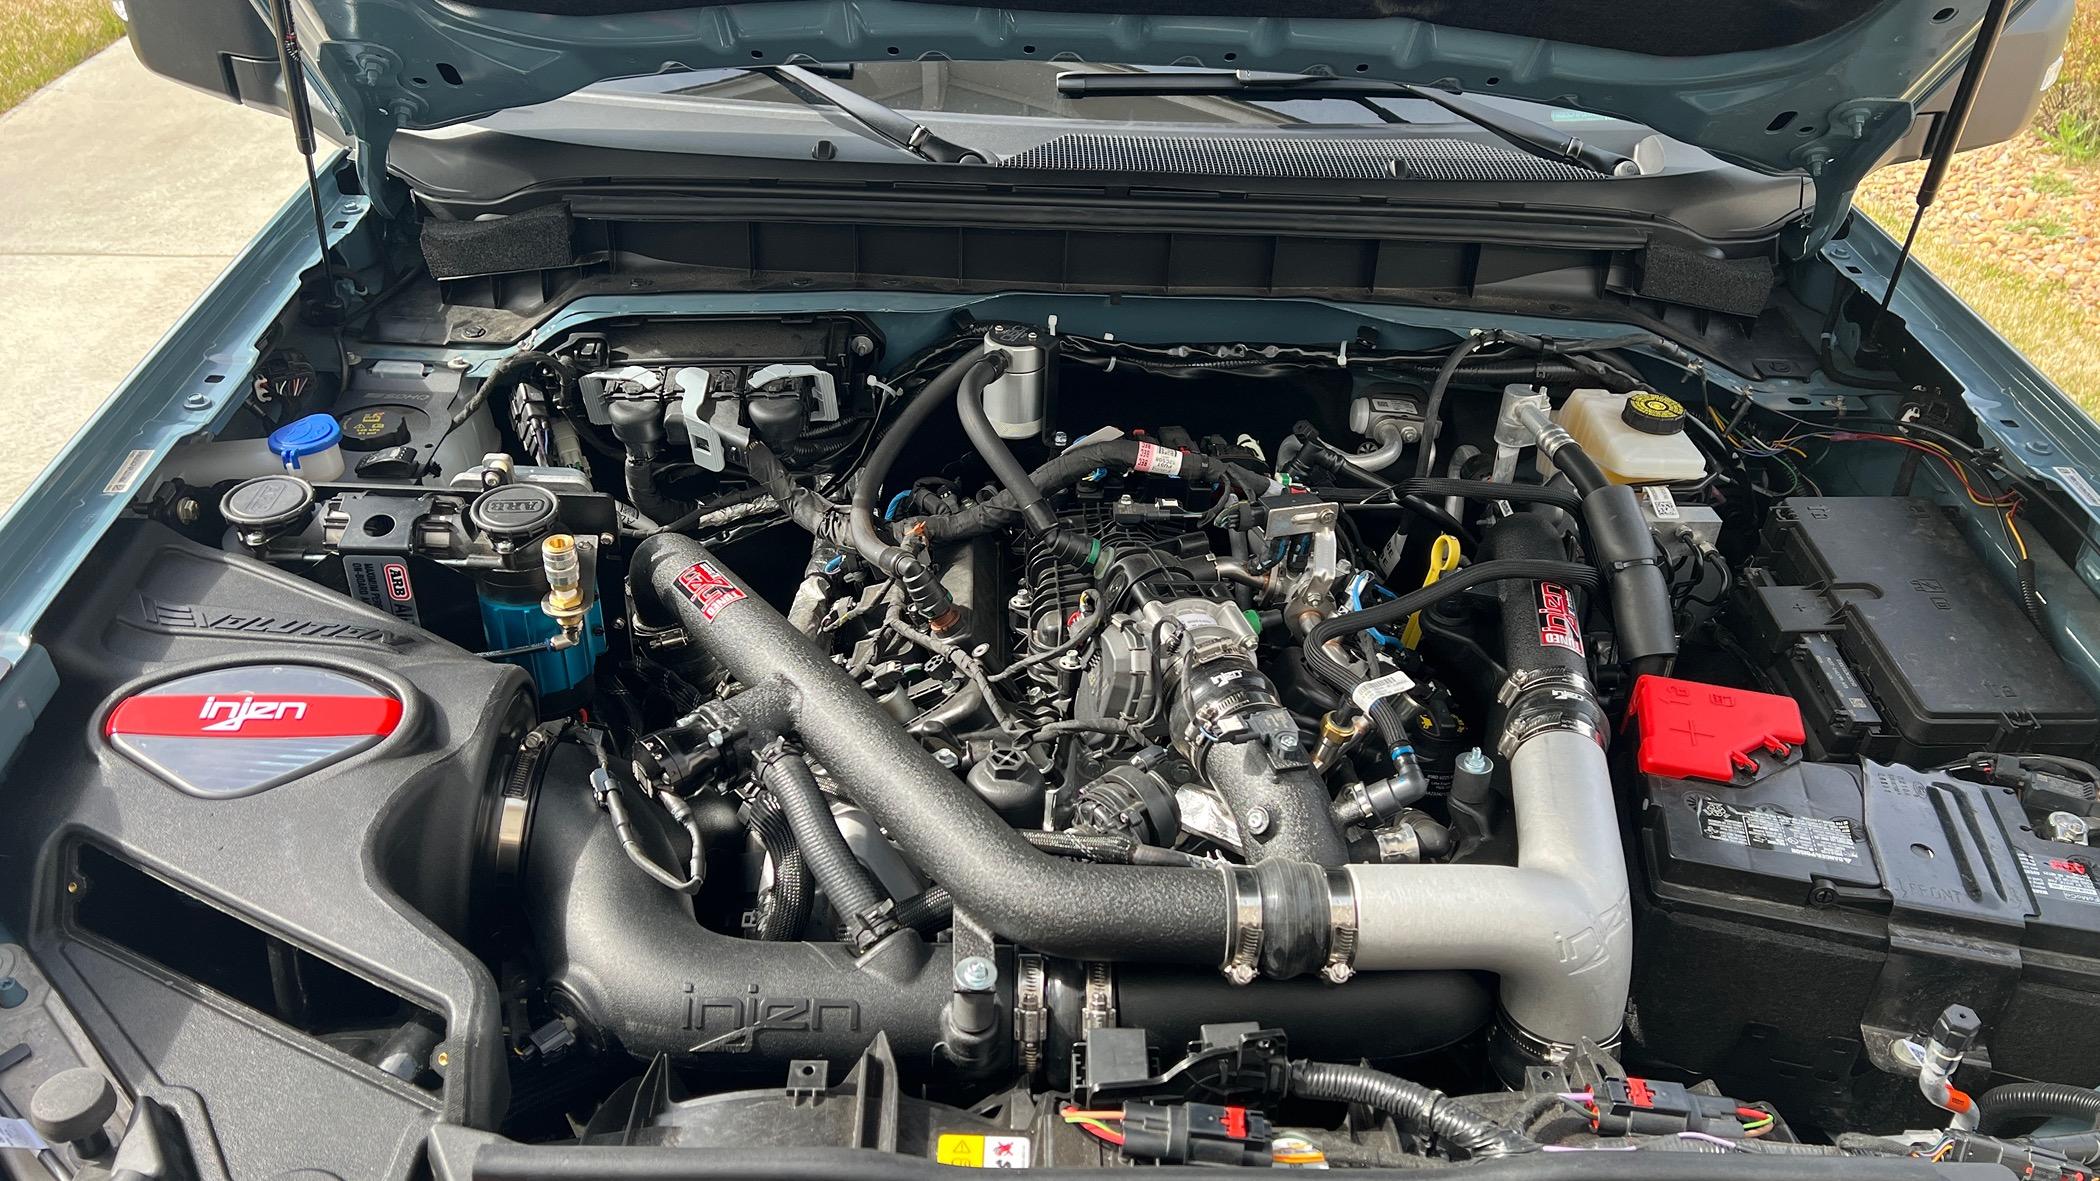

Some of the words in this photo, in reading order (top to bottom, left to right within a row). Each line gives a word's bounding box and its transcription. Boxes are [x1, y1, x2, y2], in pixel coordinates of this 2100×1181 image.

[364, 563, 380, 593] MAXIMUM
[389, 568, 406, 596] ARB
[1545, 632, 1581, 652] TUNED
[199, 696, 307, 731] injen
[681, 983, 861, 1053] injen
